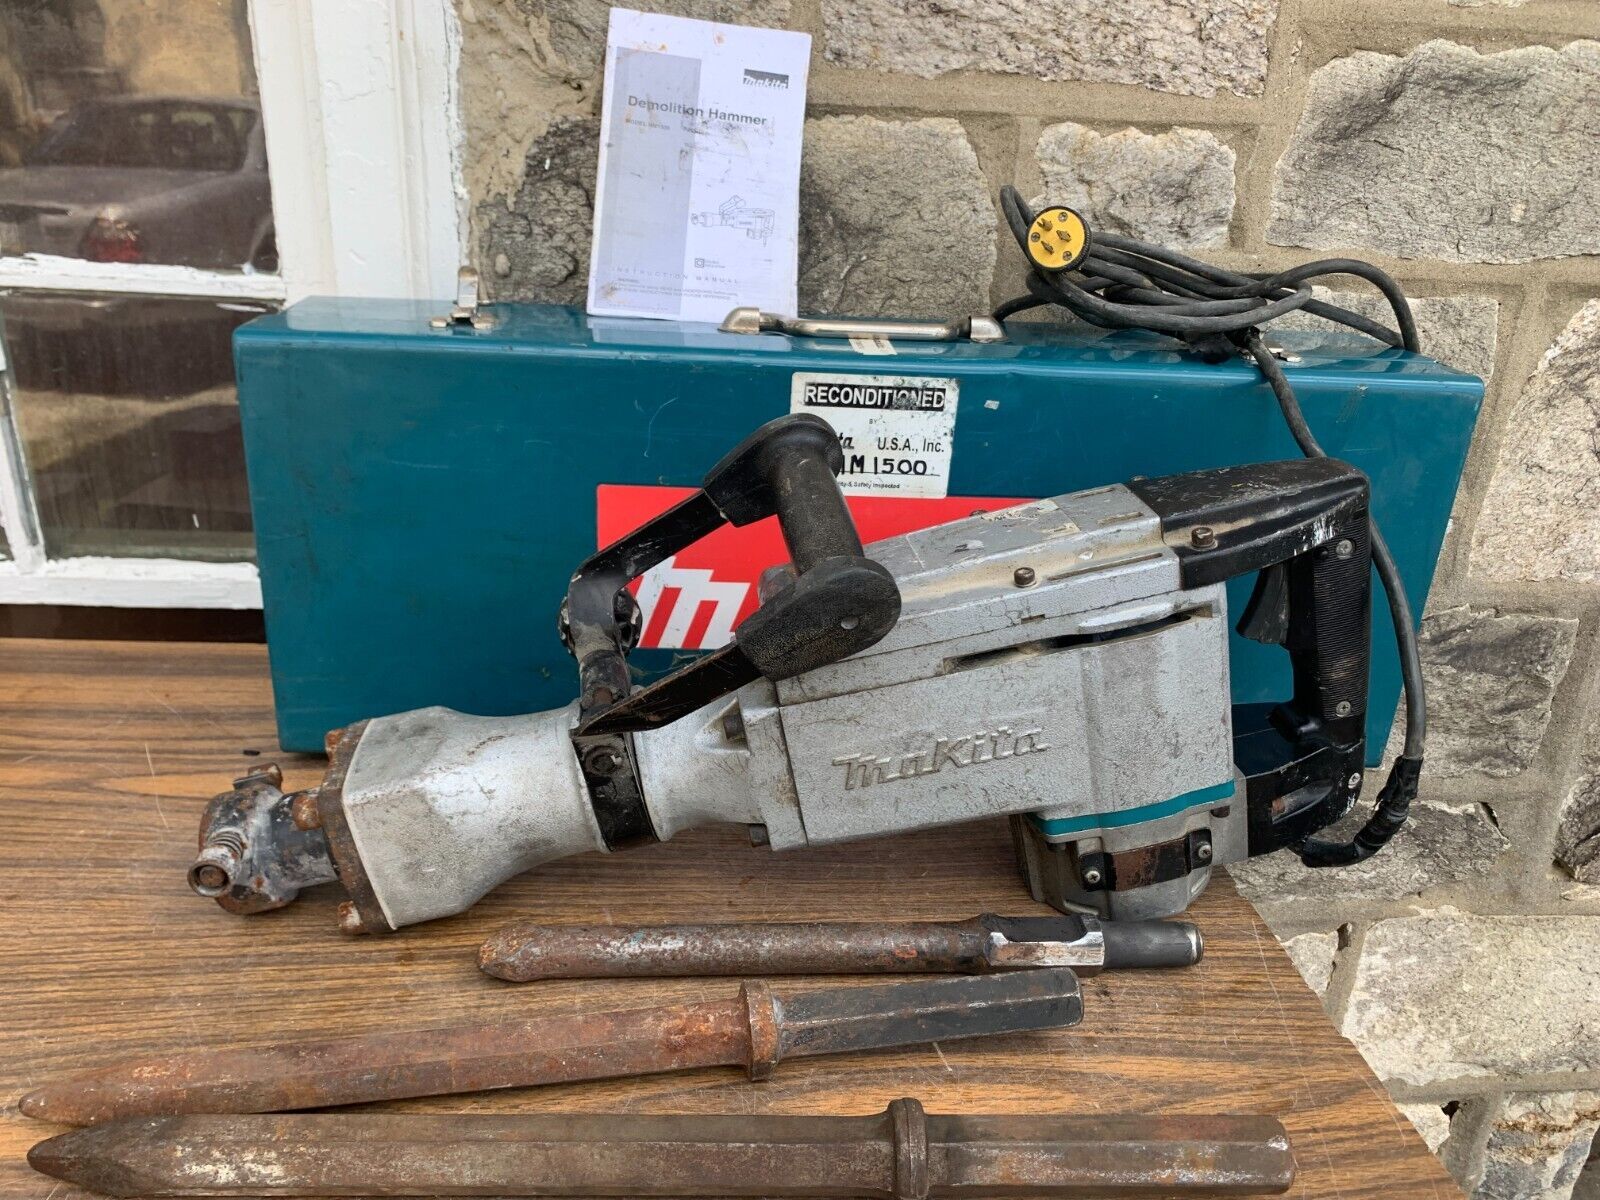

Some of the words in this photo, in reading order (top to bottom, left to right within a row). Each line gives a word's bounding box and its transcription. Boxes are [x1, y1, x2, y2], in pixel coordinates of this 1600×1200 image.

[628, 95, 704, 117] Demolition
[708, 107, 767, 126] Hammer
[804, 385, 945, 408] RECONDITIONED
[922, 438, 945, 453] Inc.
